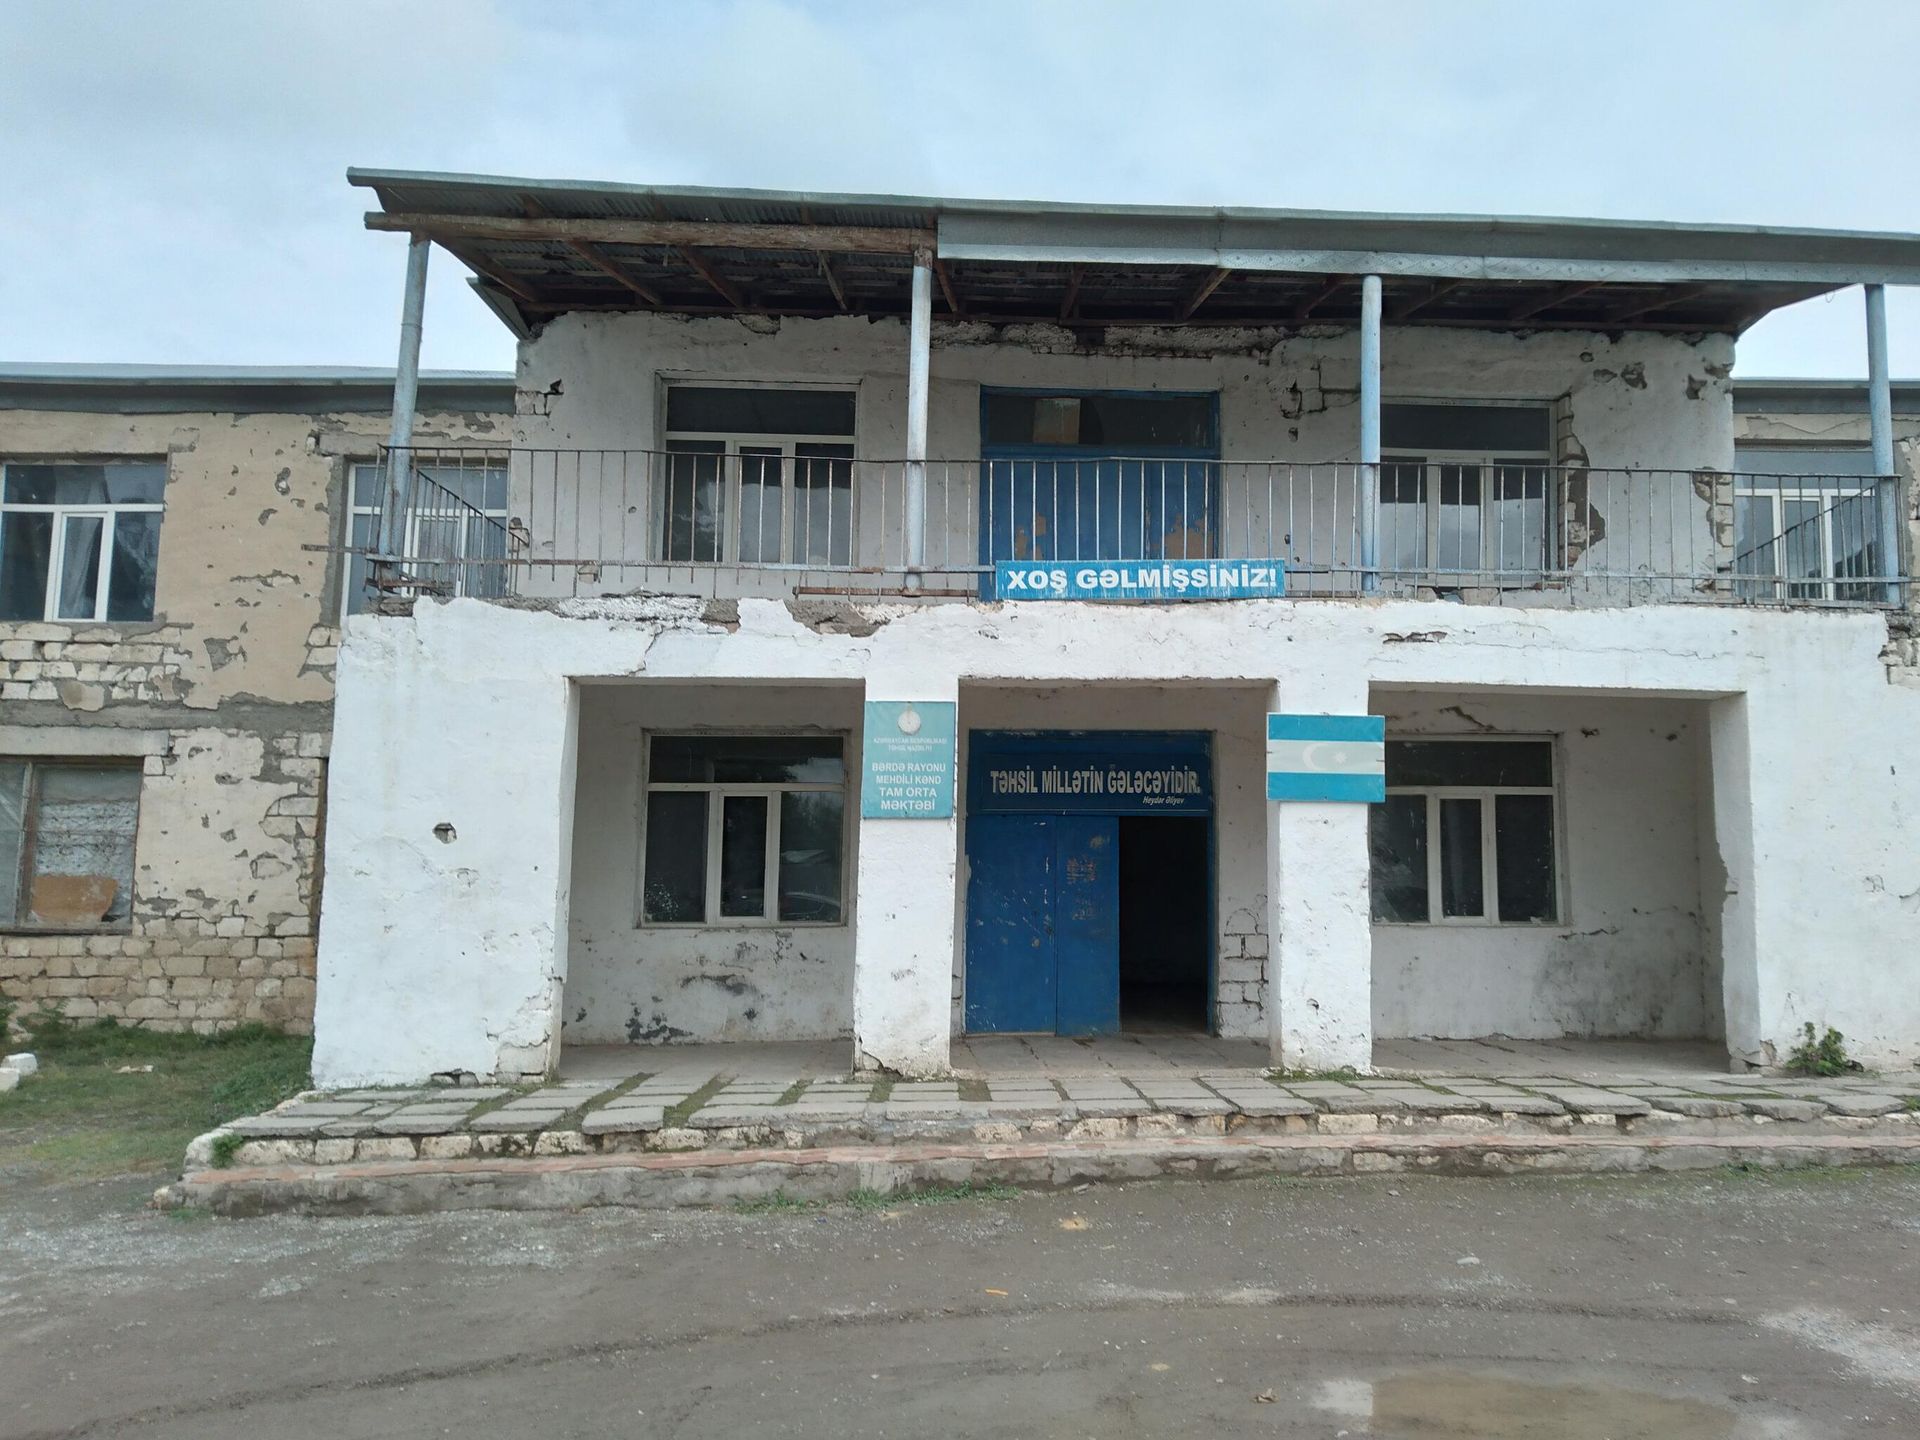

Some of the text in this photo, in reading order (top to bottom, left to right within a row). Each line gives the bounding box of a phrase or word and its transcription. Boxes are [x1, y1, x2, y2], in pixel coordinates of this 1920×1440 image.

[1007, 564, 1277, 593] XOŞ GƏLMİŞSİNİZ!
[872, 762, 946, 773] BƏRDƏ RAYONU
[876, 773, 942, 785] MEHDİLİ KƏND
[990, 764, 1038, 794] TƏHSİL
[1041, 764, 1104, 794] MİLLƏTİN
[880, 787, 938, 798] TAM ORTA
[880, 798, 936, 811] MƏKTƏBİ
